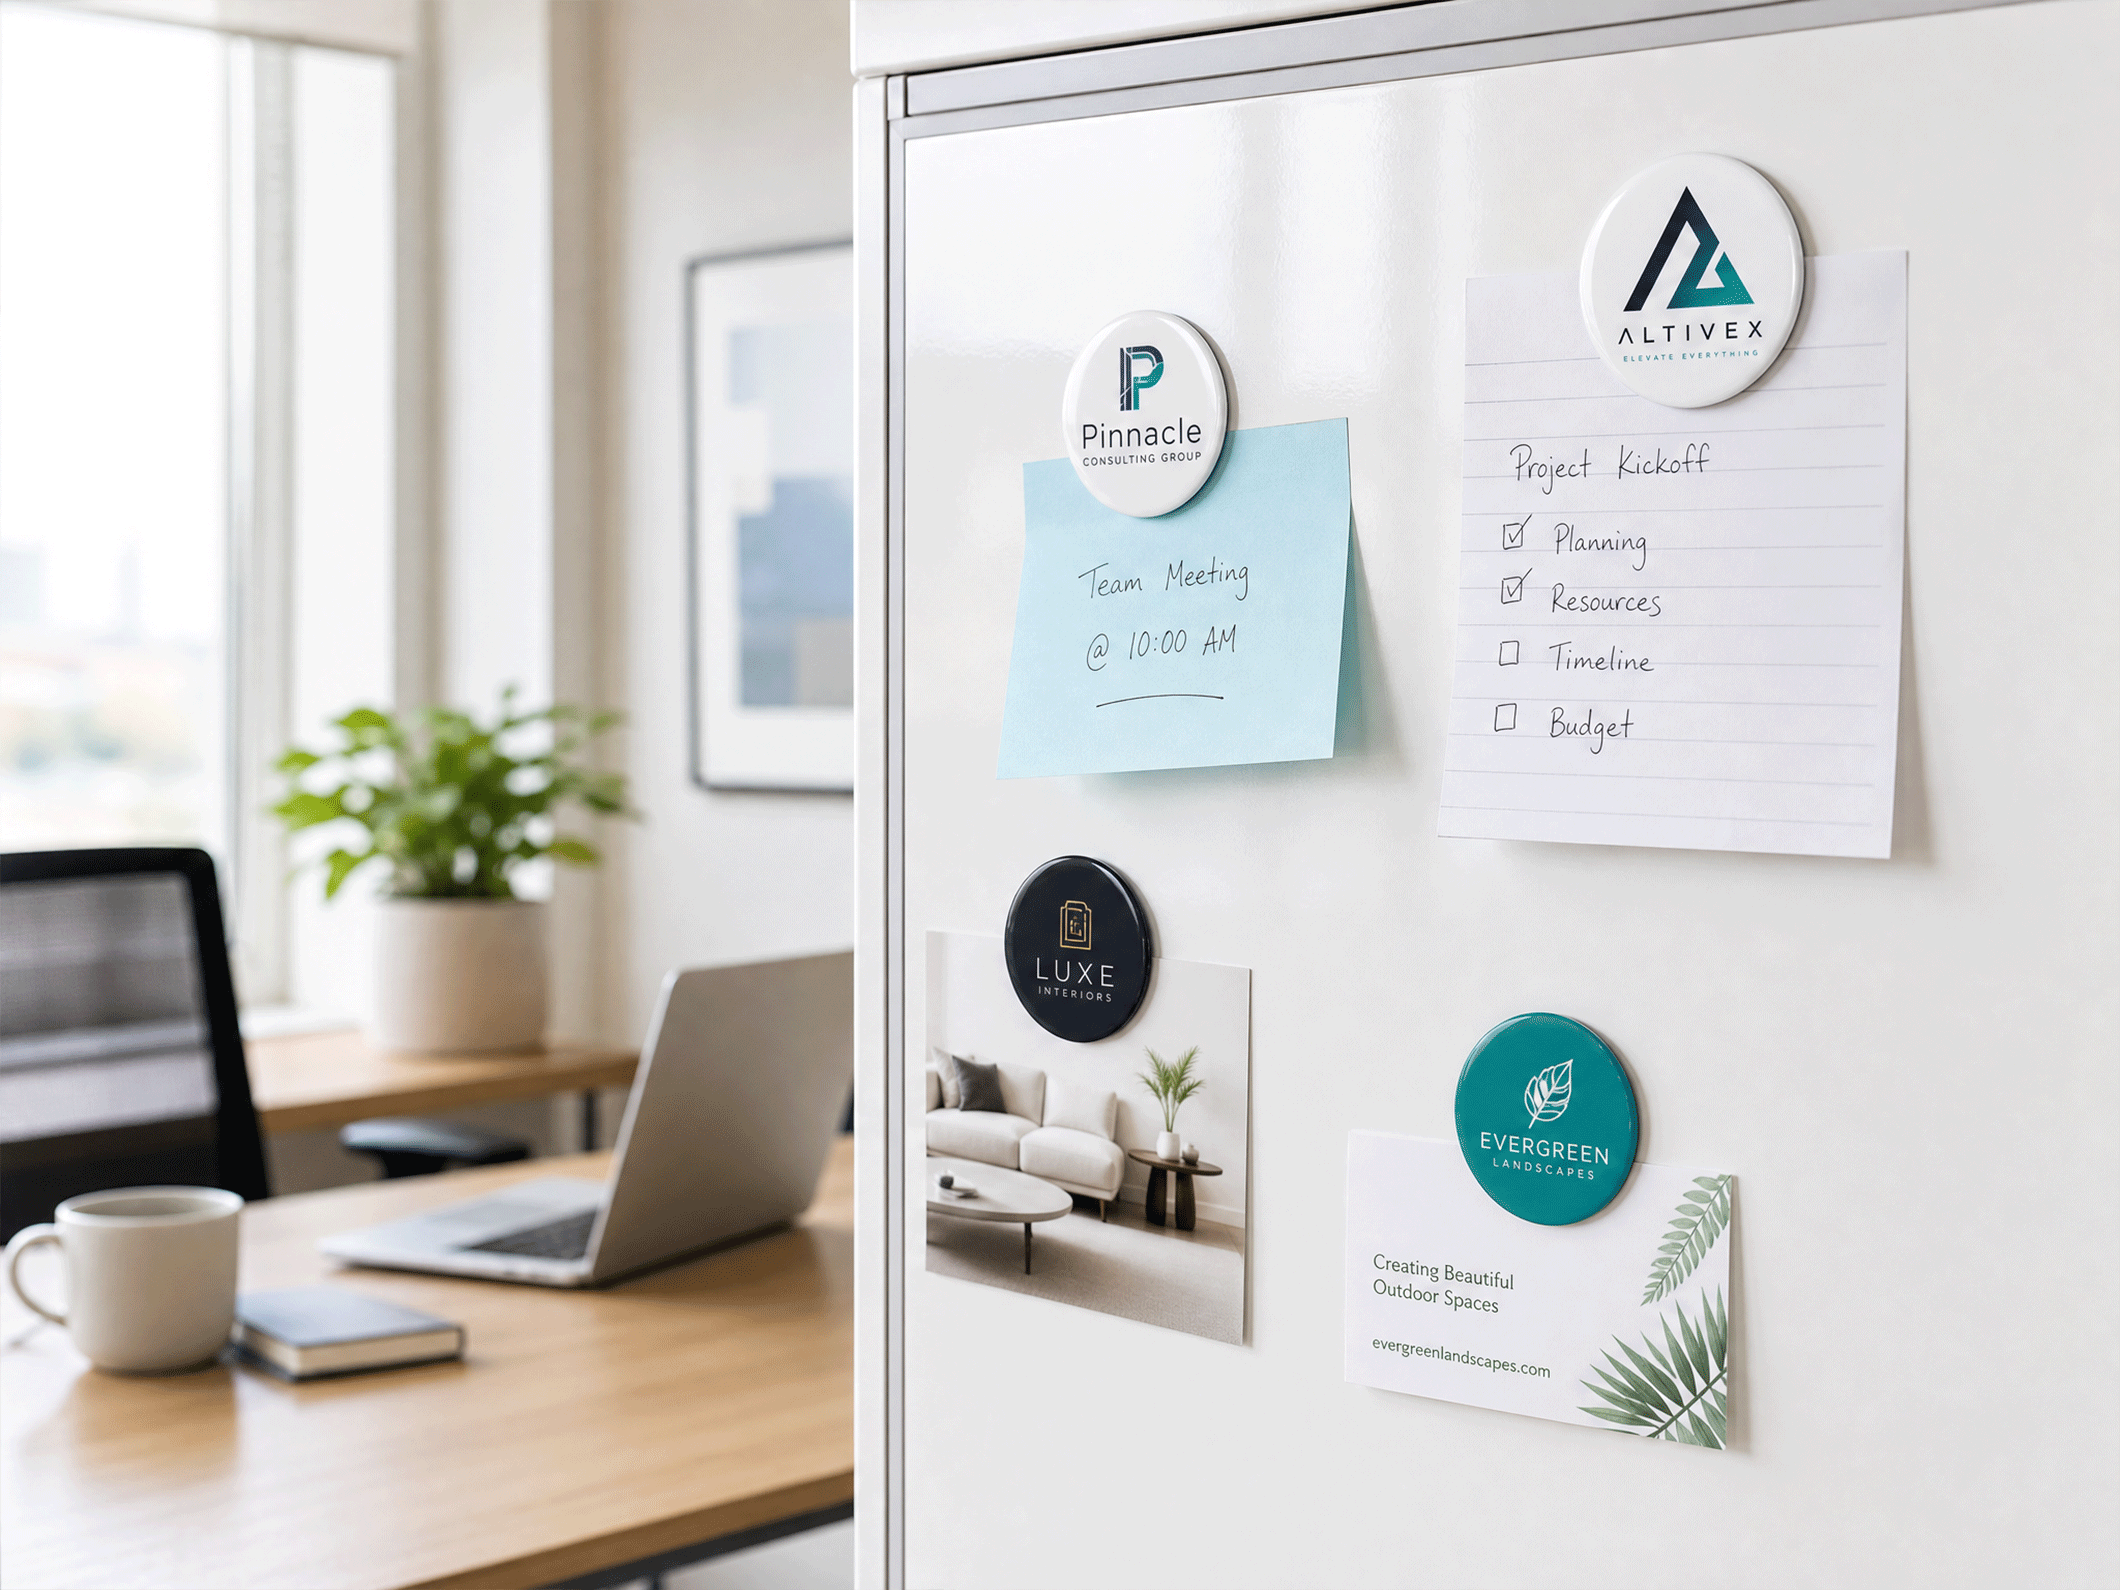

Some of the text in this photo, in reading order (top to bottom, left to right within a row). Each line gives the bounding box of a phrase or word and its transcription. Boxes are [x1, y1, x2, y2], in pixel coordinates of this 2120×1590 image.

[1618, 320, 1763, 345] ALTIVEX
[1623, 350, 1759, 362] ELEVATE EVERYTHING
[1083, 417, 1202, 449] Pinnacle
[1083, 451, 1202, 466] CONSULTING GROUP
[1509, 442, 1710, 495] Project Kickoff
[1553, 522, 1646, 571] Planning
[1078, 556, 1249, 601] Team Meeting
[1551, 582, 1662, 617] Resources
[1086, 624, 1236, 671] @ 10:00 AM
[1549, 641, 1655, 671] Timeline
[1550, 706, 1634, 754] Budget
[1036, 957, 1114, 987] LUXE
[1038, 986, 1112, 1002] INTERIORS
[1480, 1131, 1609, 1165] EVERGREEN
[1493, 1157, 1594, 1180] LANDSCAPES
[1373, 1253, 1514, 1290] Creating Beautiful
[1373, 1278, 1499, 1314] Outdoor Spaces
[1372, 1338, 1551, 1379] evergreenlandscapes.com
